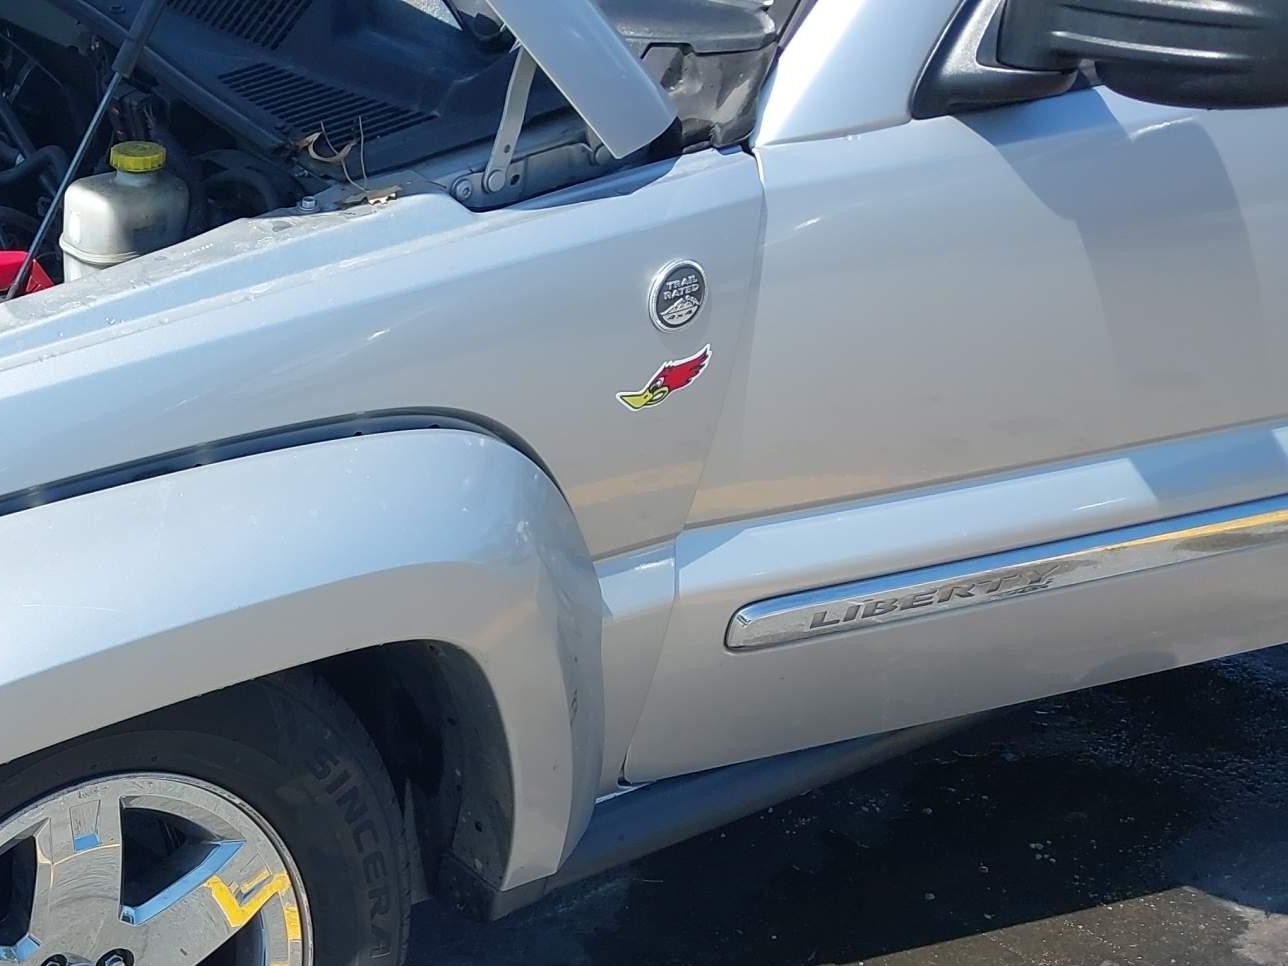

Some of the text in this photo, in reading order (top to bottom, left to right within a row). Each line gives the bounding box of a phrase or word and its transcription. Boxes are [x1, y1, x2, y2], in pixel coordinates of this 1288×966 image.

[663, 284, 699, 300] RATED
[666, 275, 698, 290] TRAIL
[809, 565, 1060, 630] LIBERTY
[308, 745, 393, 960] SINCERA
